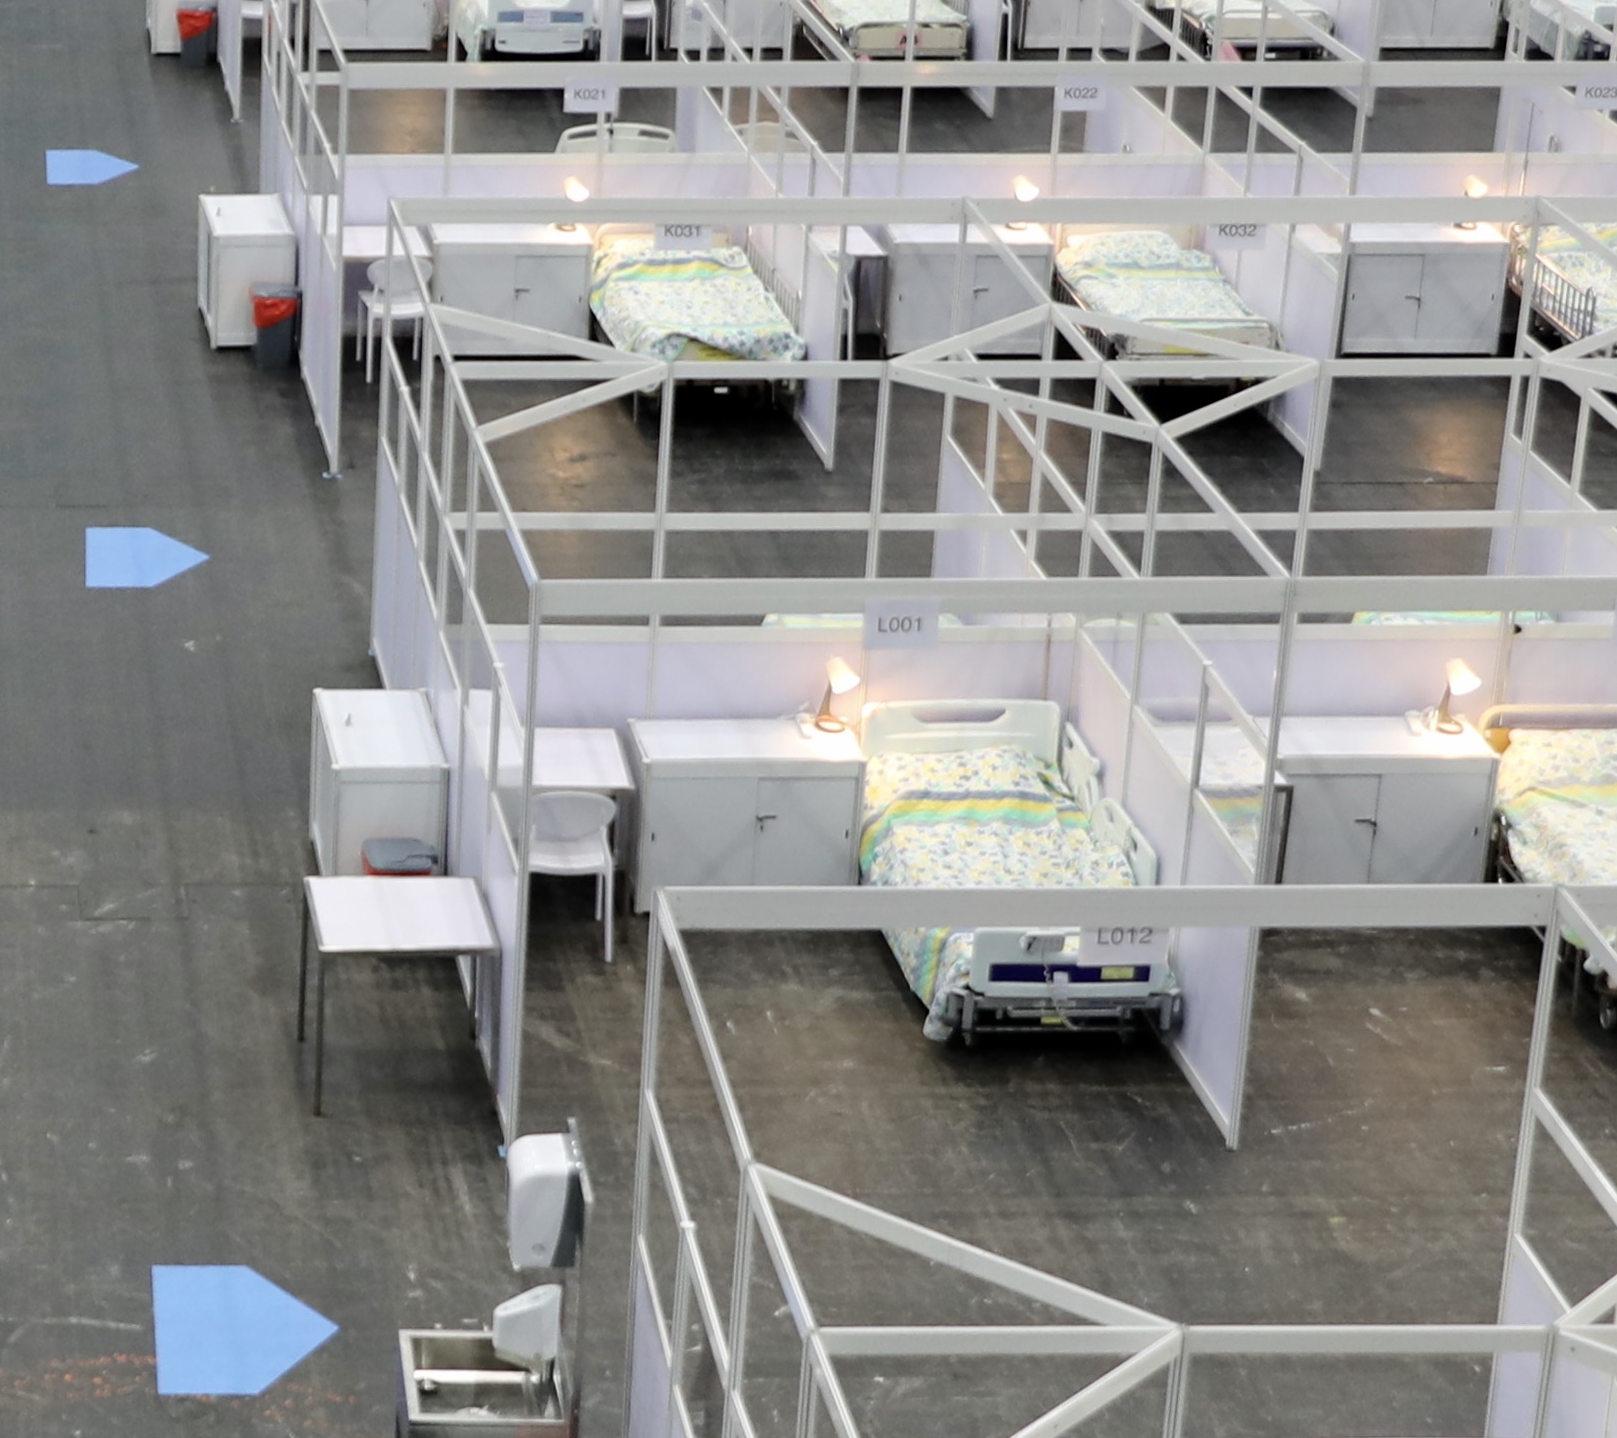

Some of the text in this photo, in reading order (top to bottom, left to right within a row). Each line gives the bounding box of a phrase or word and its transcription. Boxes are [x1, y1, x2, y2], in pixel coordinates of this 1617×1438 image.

[574, 88, 606, 99] K021
[1064, 88, 1098, 99] K022
[664, 224, 701, 237] K031
[1218, 224, 1257, 237] K032
[878, 617, 922, 633] L001
[1097, 927, 1154, 945] L012
